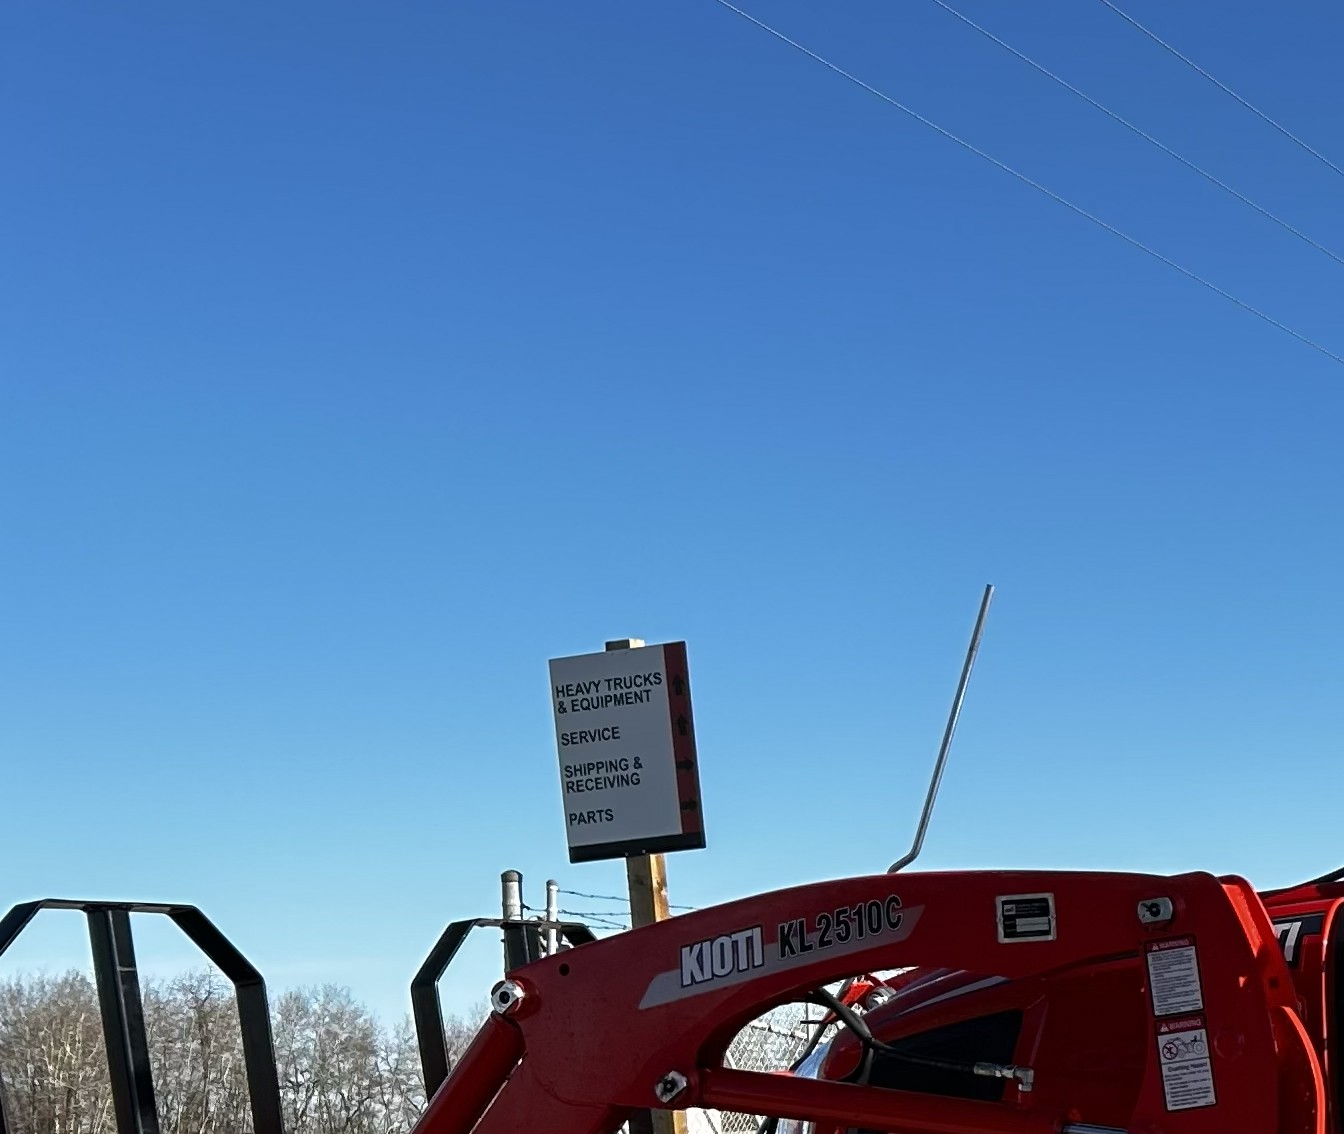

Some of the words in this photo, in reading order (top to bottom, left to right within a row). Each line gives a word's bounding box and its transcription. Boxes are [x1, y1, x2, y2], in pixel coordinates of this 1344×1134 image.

[556, 679, 602, 698] HEAVY
[604, 672, 662, 692] TRUCKS
[558, 700, 568, 714] &
[571, 689, 652, 713] EQUIPMENT
[561, 726, 620, 746] SERVICE
[564, 758, 629, 778] SHIPPING
[633, 756, 643, 770] &
[566, 772, 641, 794] RECEIVING
[568, 808, 614, 826] PARTS
[680, 924, 765, 988] KIOTI
